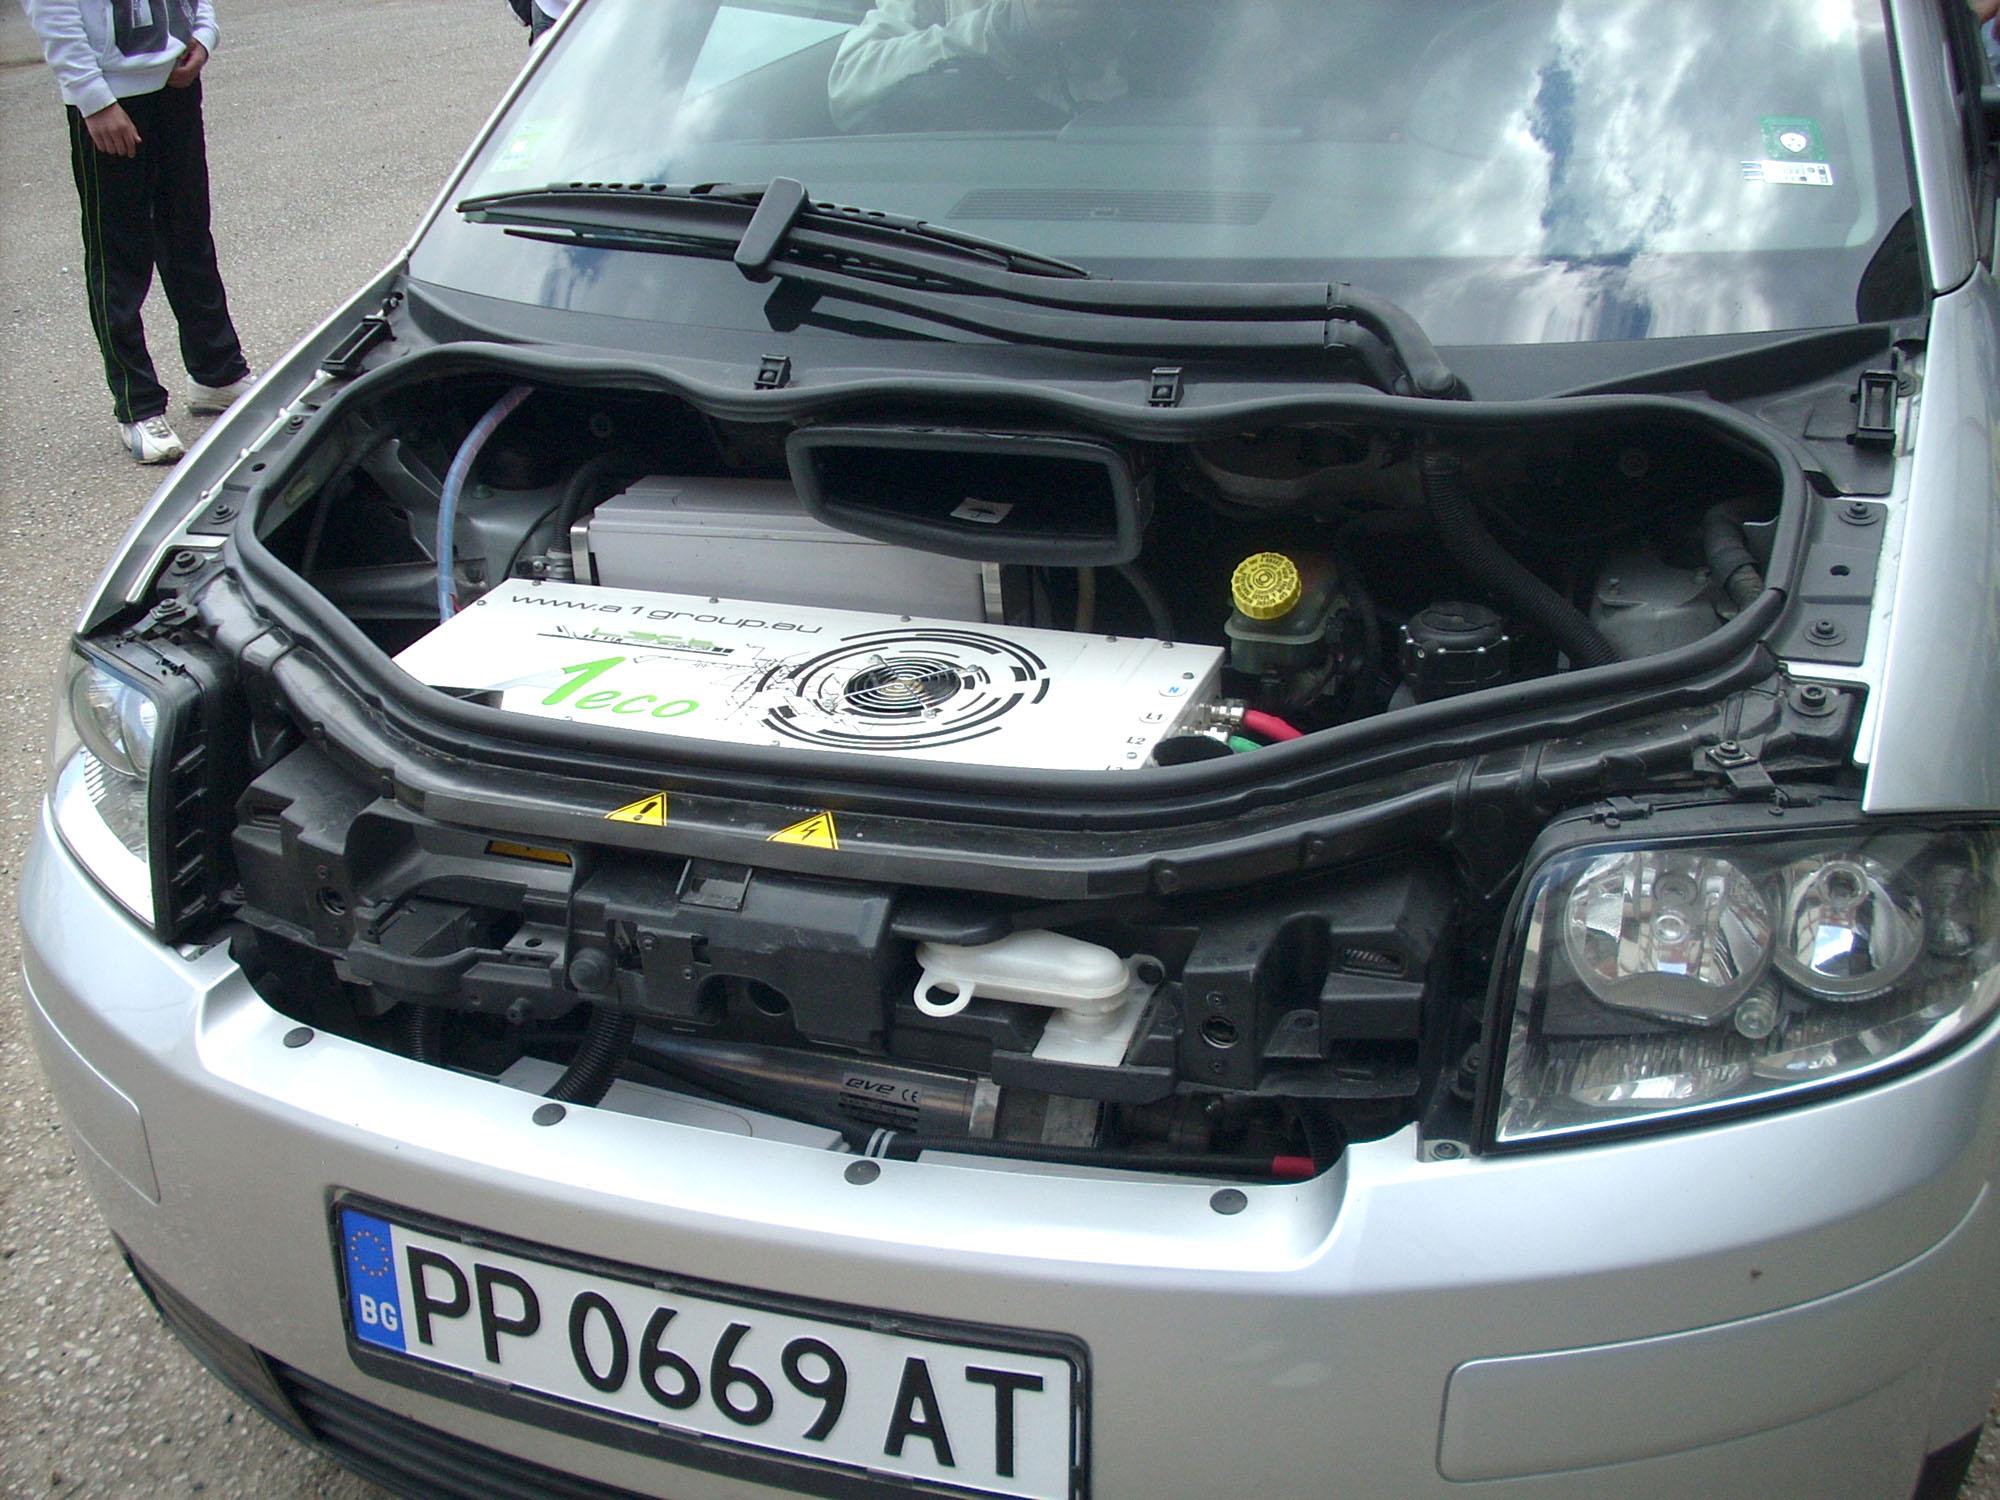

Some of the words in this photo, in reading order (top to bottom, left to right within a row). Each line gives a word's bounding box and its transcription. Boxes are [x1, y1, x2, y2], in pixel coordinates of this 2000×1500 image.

[512, 595, 823, 634] www.a1group.eu
[542, 656, 700, 718] 1eco
[1168, 686, 1180, 694] N
[1145, 712, 1163, 721] L1
[1126, 736, 1147, 745] L2
[360, 1294, 399, 1332] BG
[406, 1245, 541, 1364] PP
[569, 1290, 848, 1442] 0669
[884, 1356, 1044, 1478] AT
